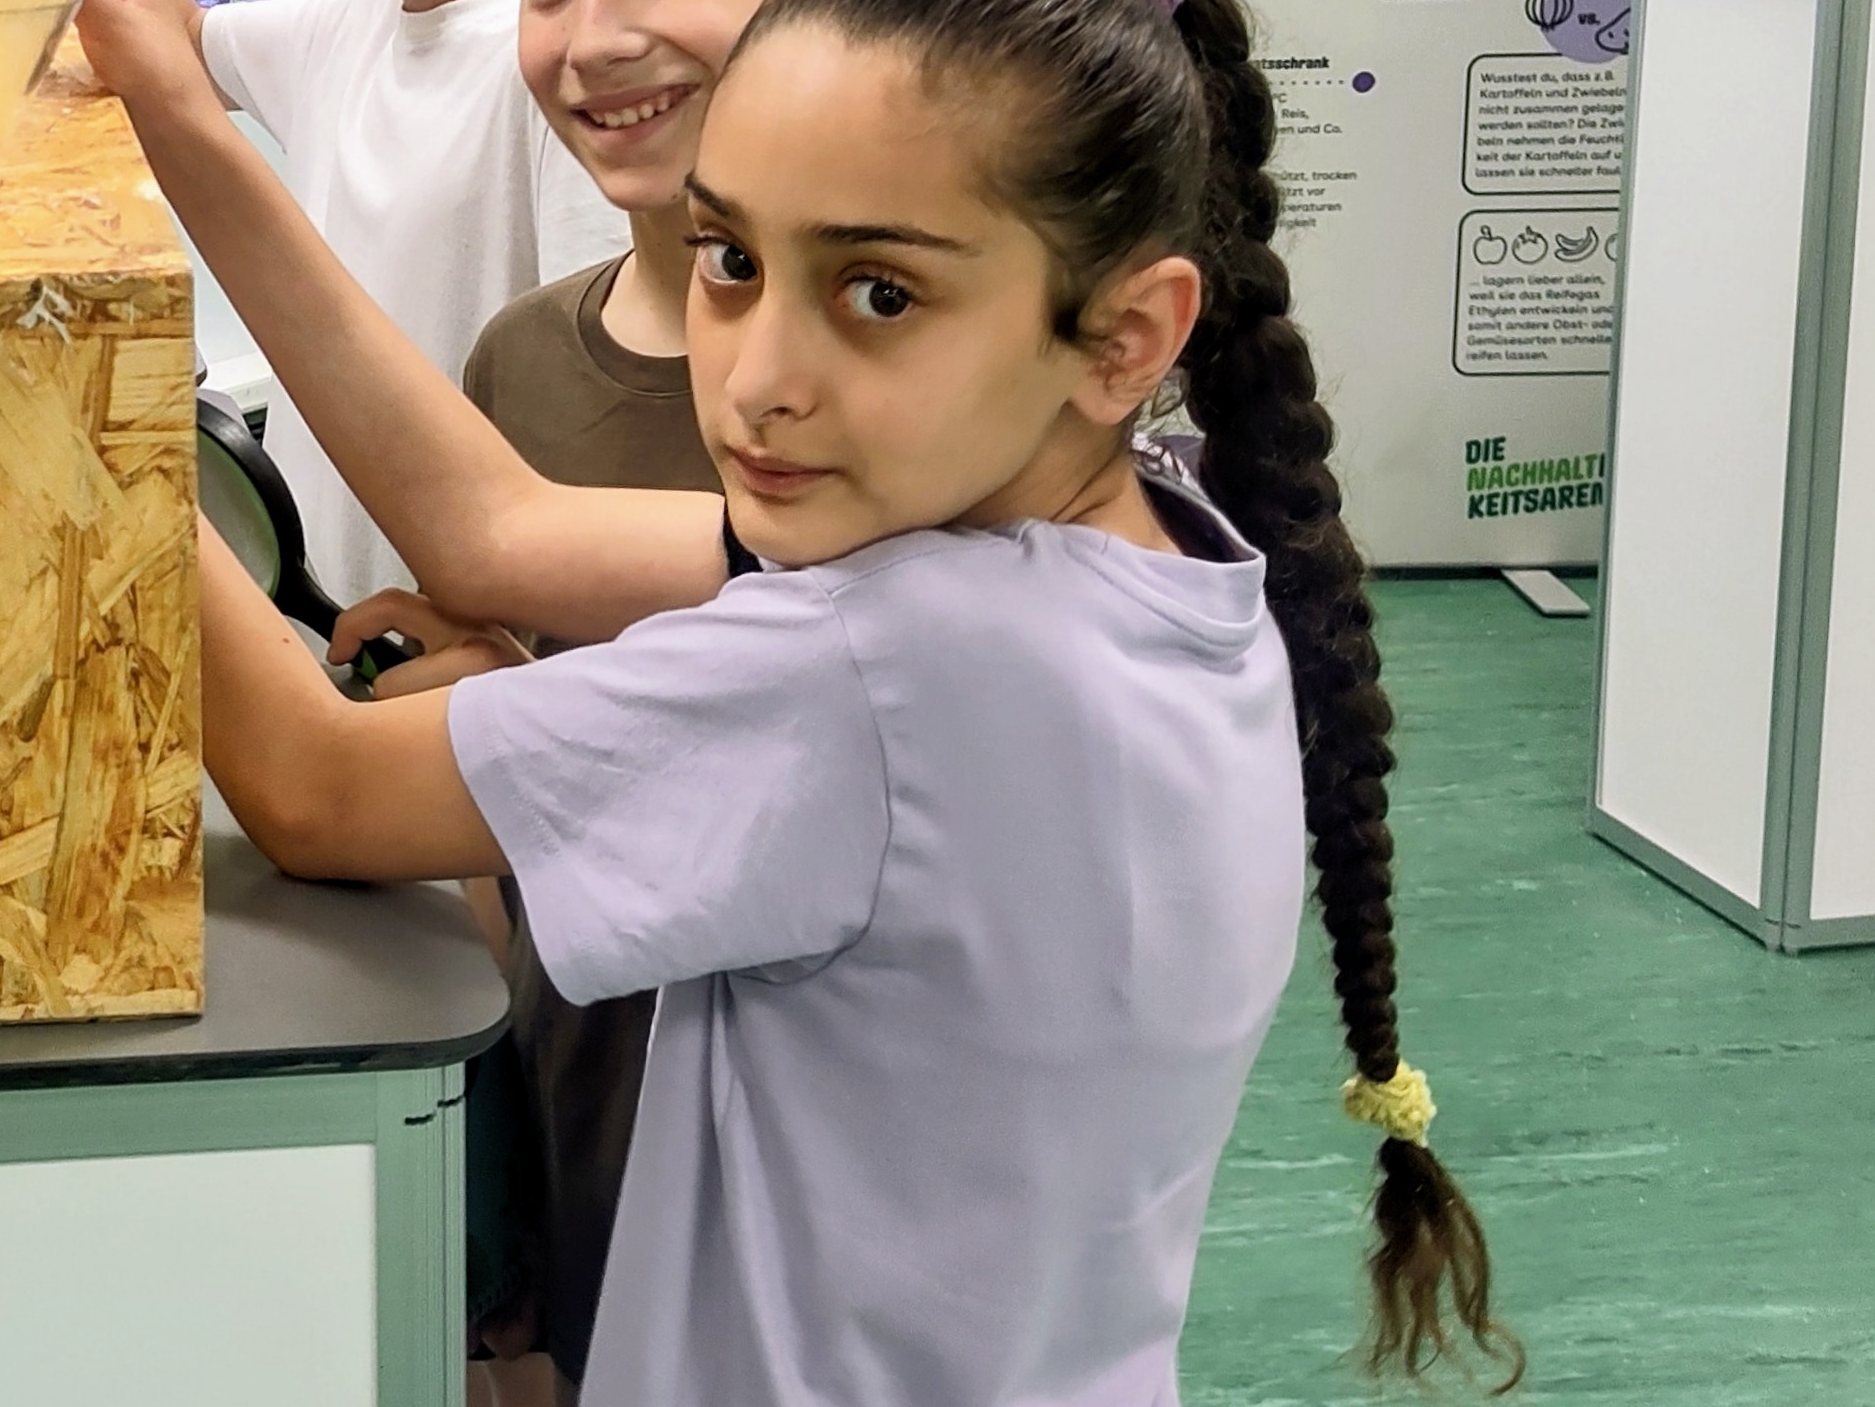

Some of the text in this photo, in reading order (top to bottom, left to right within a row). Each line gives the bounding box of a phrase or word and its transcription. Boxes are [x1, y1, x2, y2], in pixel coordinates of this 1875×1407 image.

[1578, 14, 1600, 24] vs.
[1481, 73, 1537, 83] Wusstest
[1562, 72, 1590, 81] dass
[1480, 89, 1543, 98] Kartoffeln
[1546, 88, 1568, 97] und
[1479, 104, 1578, 114] nicht zusammen
[1297, 124, 1320, 133] und
[1478, 121, 1523, 130] werden
[1527, 119, 1574, 129] sollten?
[1577, 119, 1596, 128] Die
[1507, 135, 1554, 145] nehmen
[1558, 135, 1576, 144] die
[1477, 152, 1498, 161] keit
[1502, 152, 1522, 160] der
[1525, 151, 1587, 160] Kartoffeln
[1591, 150, 1610, 159] auf
[1312, 172, 1357, 180] trocken
[1466, 436, 1506, 464] DIE
